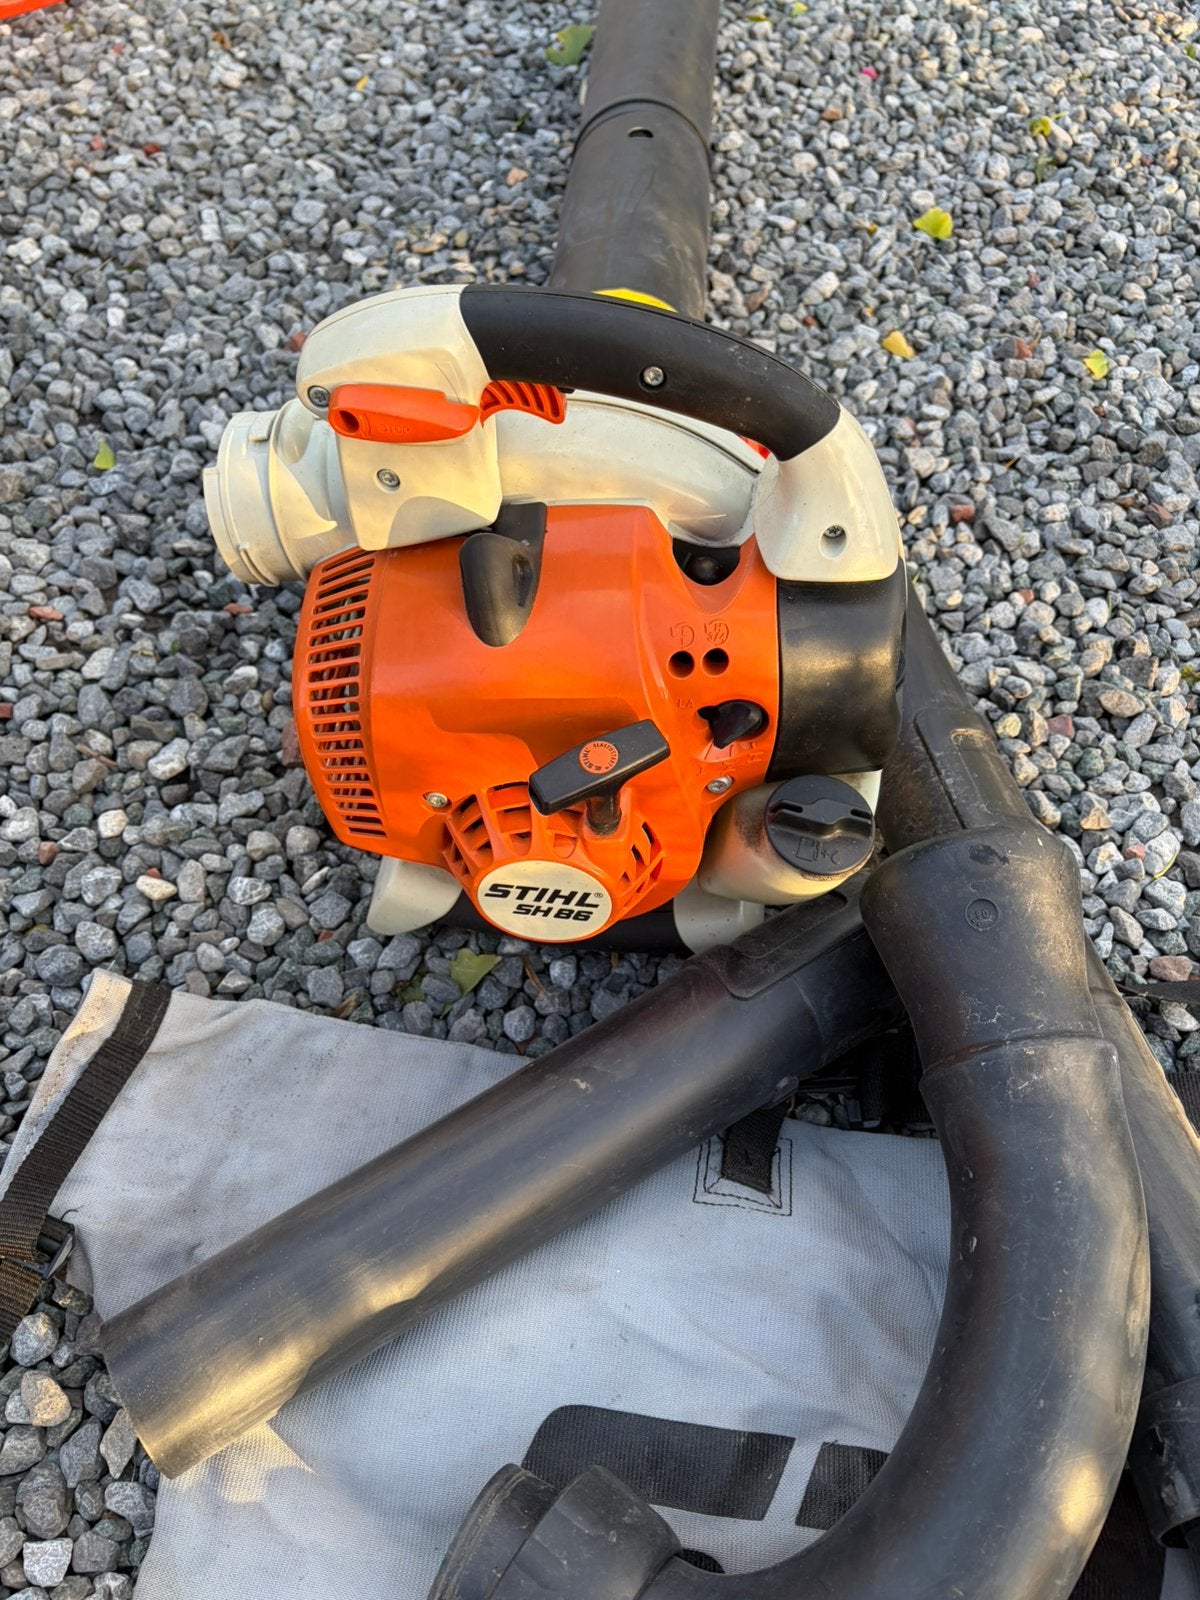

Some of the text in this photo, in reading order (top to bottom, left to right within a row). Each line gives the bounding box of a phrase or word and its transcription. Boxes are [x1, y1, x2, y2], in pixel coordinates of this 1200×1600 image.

[378, 424, 410, 434] STOP
[512, 904, 594, 921] SH 86
